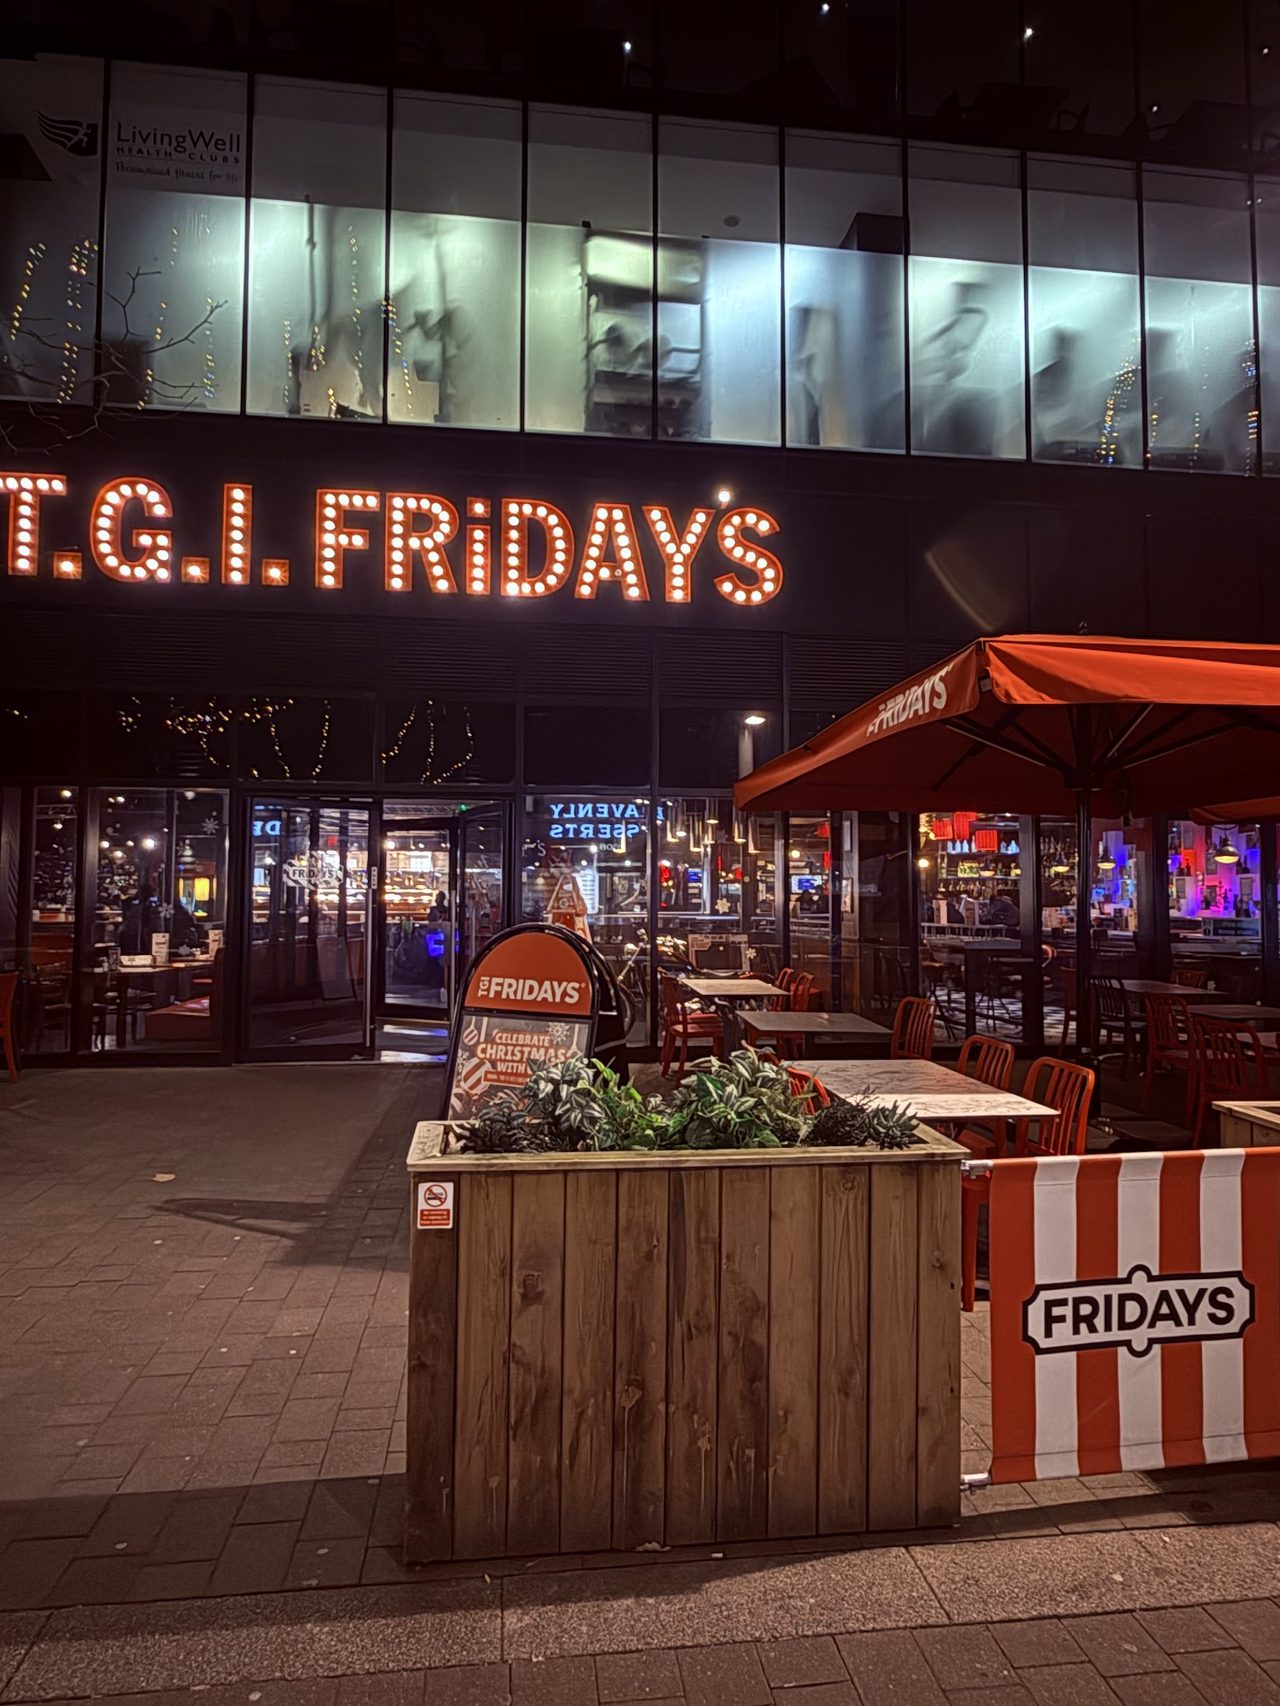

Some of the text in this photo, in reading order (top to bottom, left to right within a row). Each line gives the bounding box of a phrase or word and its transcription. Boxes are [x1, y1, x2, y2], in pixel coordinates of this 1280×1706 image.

[117, 122, 240, 153] LivingWell
[116, 147, 240, 164] HEALTH CLUBS
[477, 976, 580, 1004] TGI FRIDAYS
[495, 1032, 551, 1047] CELEBRATE
[477, 1043, 567, 1067] CHRISTMAS
[496, 1061, 526, 1074] WITH
[1043, 1286, 1235, 1339] FRIDAYS
